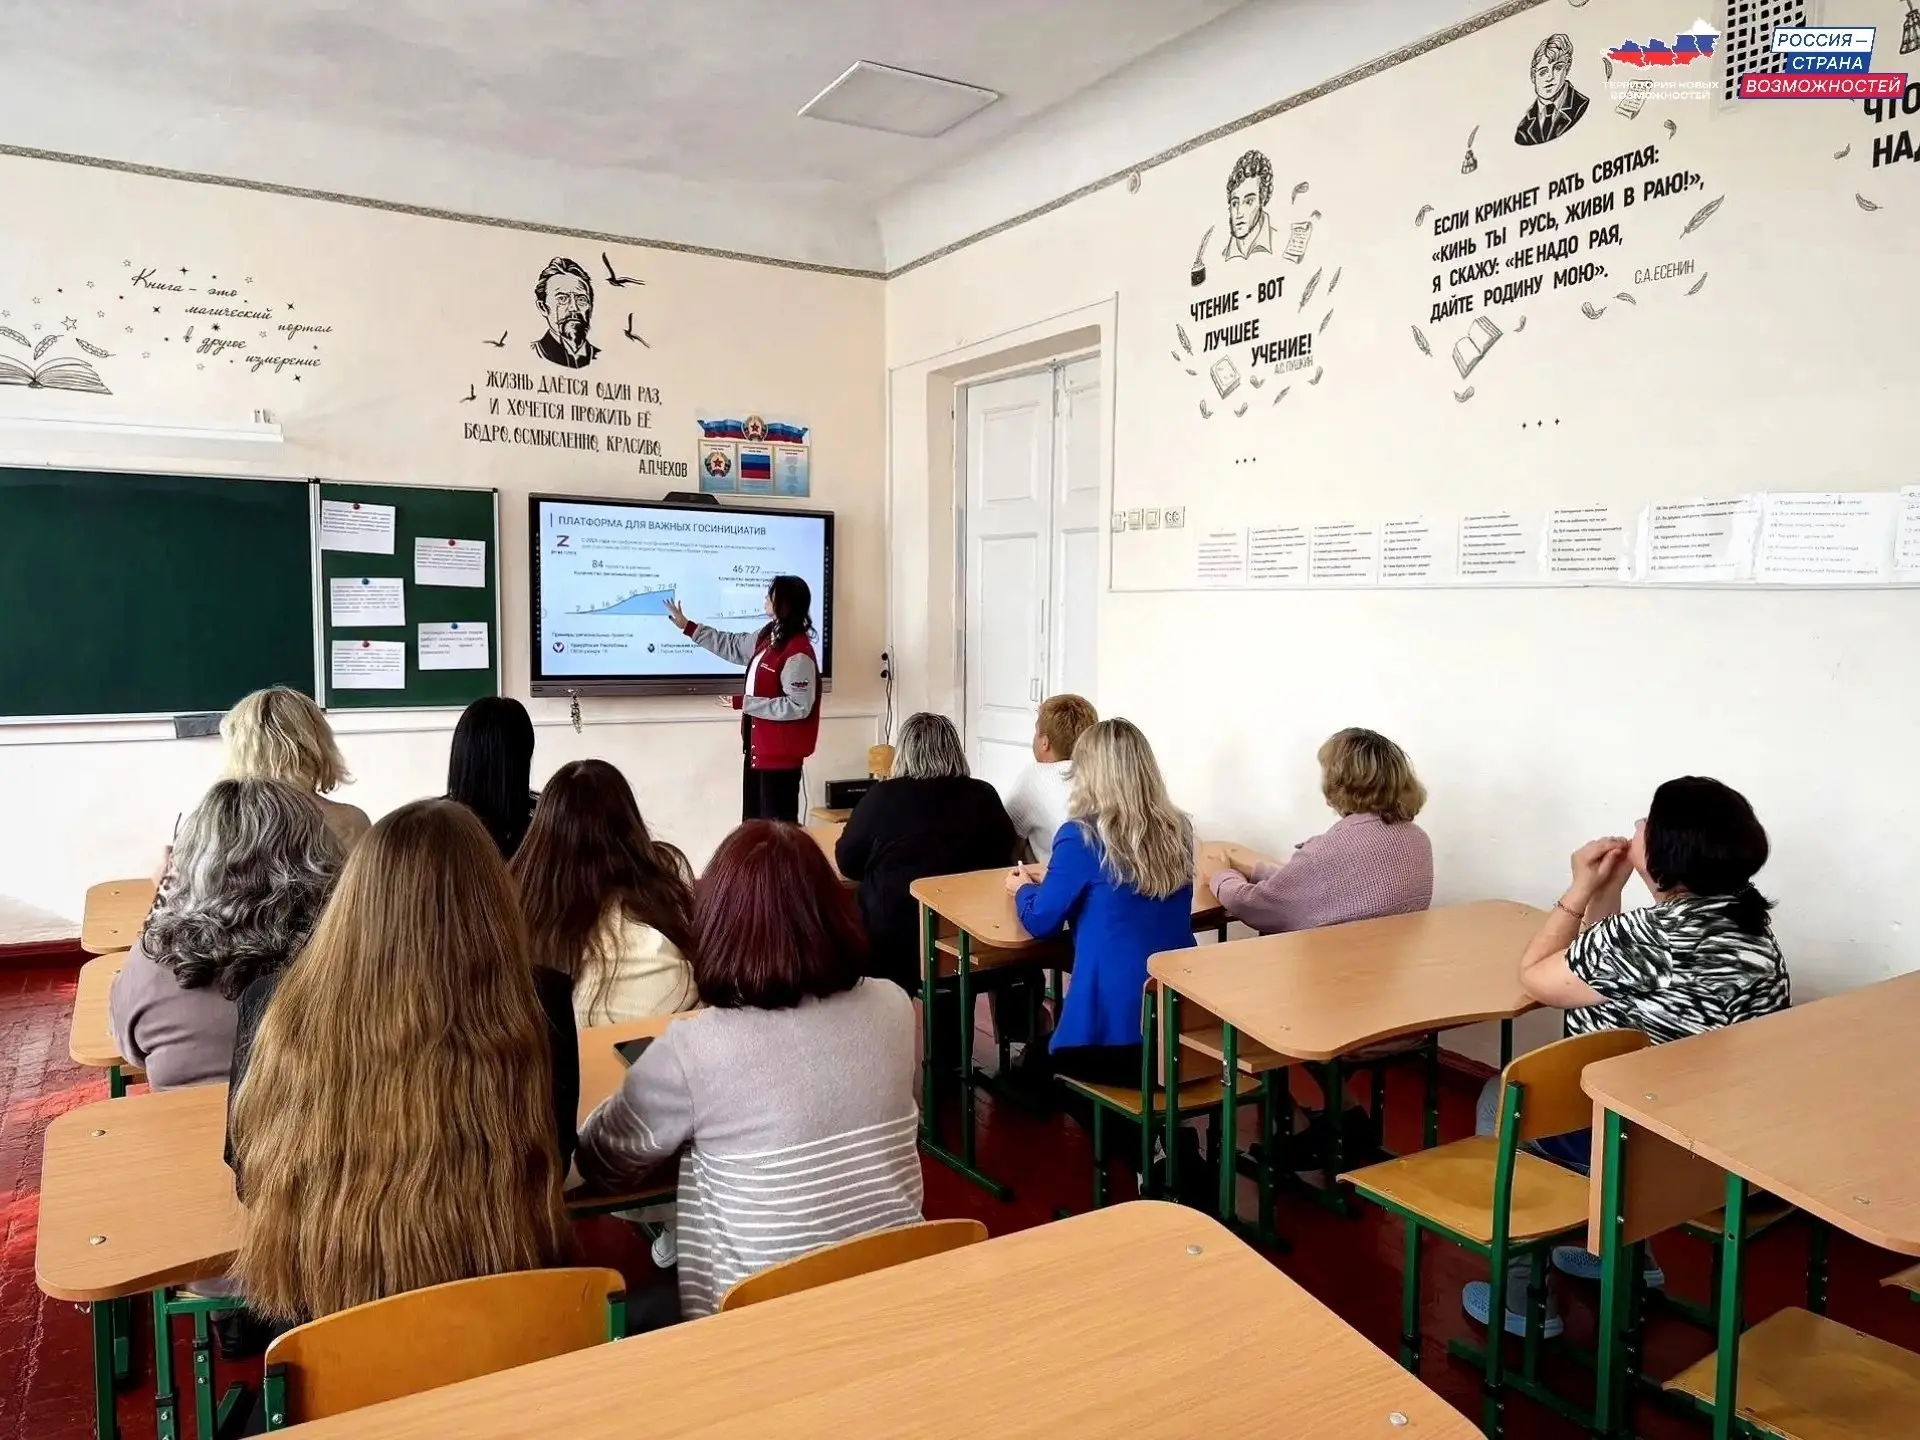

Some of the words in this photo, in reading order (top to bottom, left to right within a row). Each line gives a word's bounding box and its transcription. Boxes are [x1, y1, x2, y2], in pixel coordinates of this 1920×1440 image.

[1434, 210, 1469, 237] ЕСЛИ
[1475, 186, 1539, 225] КРИКНЕТ
[1549, 172, 1585, 200] РАТЬ
[1592, 145, 1660, 184] СВЯТАЯ:
[1432, 239, 1476, 263] «КИНЬ
[1485, 227, 1507, 250] ТЫ
[1520, 212, 1560, 238] РУСЬ,
[1565, 191, 1615, 225] ЖИВИ
[1624, 187, 1635, 207] В
[1643, 170, 1705, 202] РАЮ!»,
[1432, 275, 1442, 293] Я
[1450, 257, 1500, 286] СКАЖУ:
[1505, 248, 1534, 269] «НЕ
[1536, 235, 1579, 264] НАДО
[1589, 224, 1623, 250] РАЯ,
[131, 268, 184, 292] Книга
[208, 287, 238, 297] это
[1190, 290, 1239, 322] ЧТЕНИЕ
[1258, 276, 1285, 303] ВОТ
[1430, 294, 1474, 324] ДАЙТЕ
[1484, 275, 1543, 306] РОДИНУ
[1553, 262, 1609, 290] МОЮ».
[185, 305, 273, 320] магический
[277, 322, 333, 340] портал
[1204, 319, 1259, 352] ЛУЧШЕЕ
[183, 326, 194, 343] в
[197, 336, 247, 355] другое
[245, 355, 321, 373] измерение
[1251, 333, 1312, 366] УЧЕНИЕ!
[486, 370, 533, 390] ЖИЗНЬ
[538, 375, 589, 396] ДАЁТСЯ
[596, 381, 631, 401] ОДИН
[490, 398, 499, 415] И
[507, 398, 564, 420] ХОЧЕТСЯ
[571, 405, 631, 427] ПРОЖИТЬ
[637, 410, 652, 429] ЕЁ
[639, 459, 688, 477] А.П.ЧЕХОВ
[556, 535, 569, 548] Z
[558, 515, 624, 528] ПЛАТФОРМА
[625, 519, 646, 531] ДЛЯ
[648, 520, 691, 532] ВАЖНЫХ
[693, 523, 767, 536] ГОСИНИЦИАТИВ
[592, 560, 604, 569] 84
[733, 565, 743, 574] 46
[746, 565, 760, 574] 727
